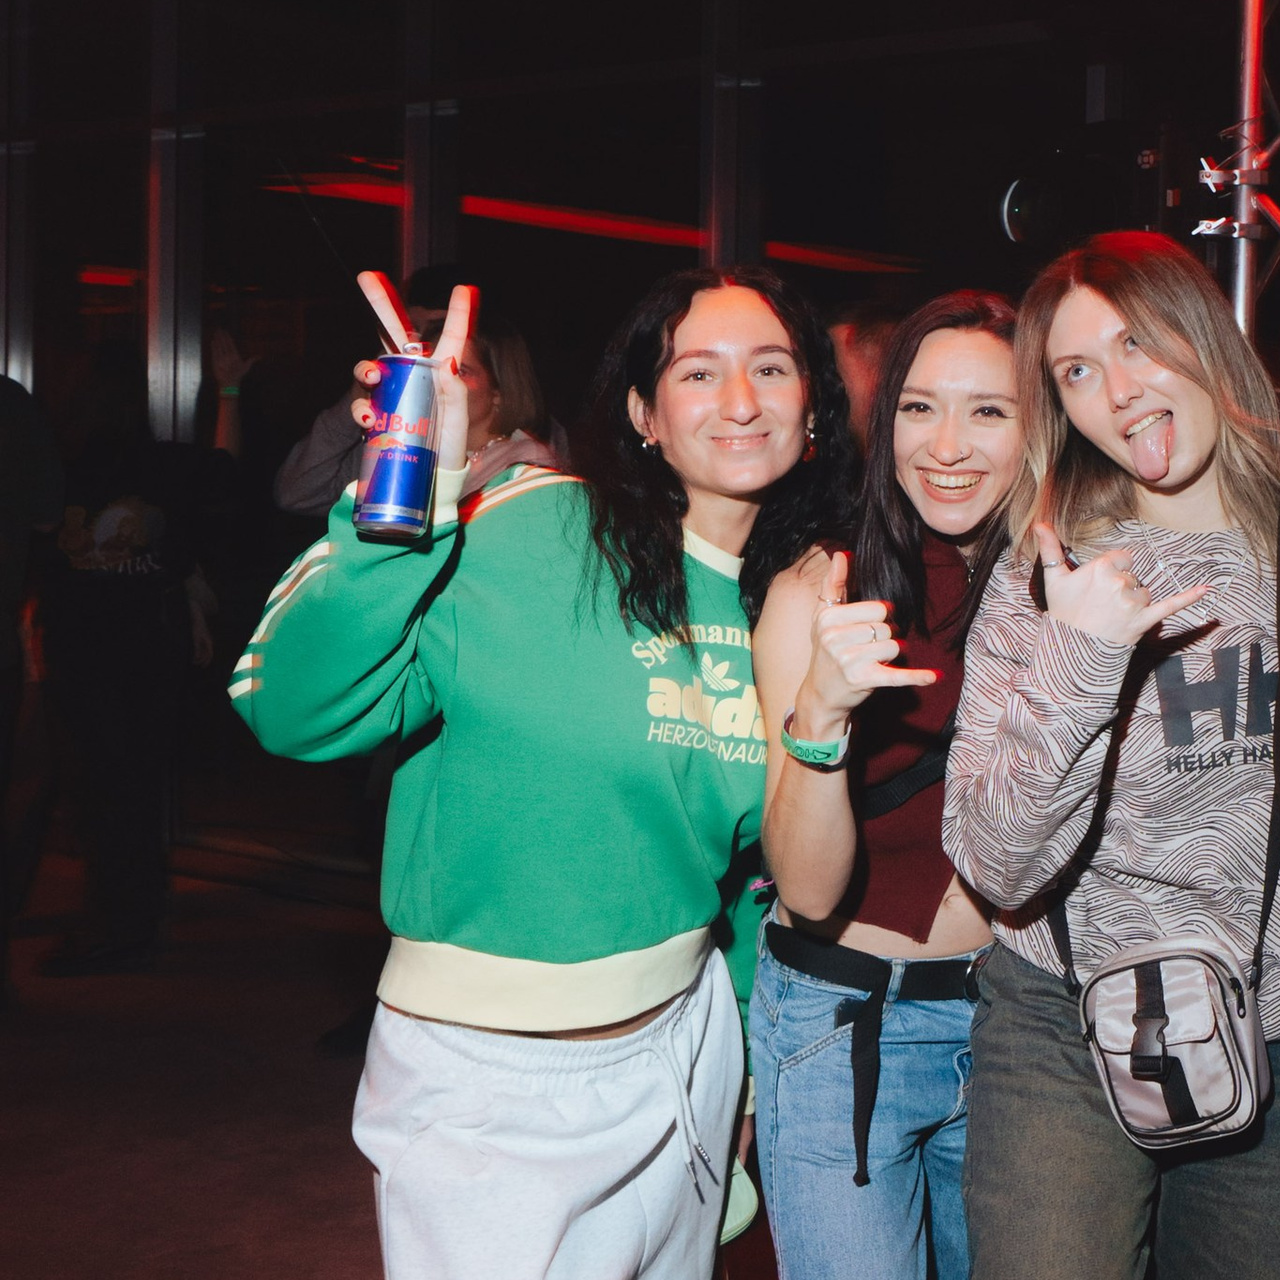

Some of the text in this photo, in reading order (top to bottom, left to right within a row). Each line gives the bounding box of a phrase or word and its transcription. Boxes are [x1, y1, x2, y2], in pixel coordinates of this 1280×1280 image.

[389, 414, 430, 437] Bull
[387, 452, 419, 464] DRINK
[1166, 748, 1235, 774] HELLY
